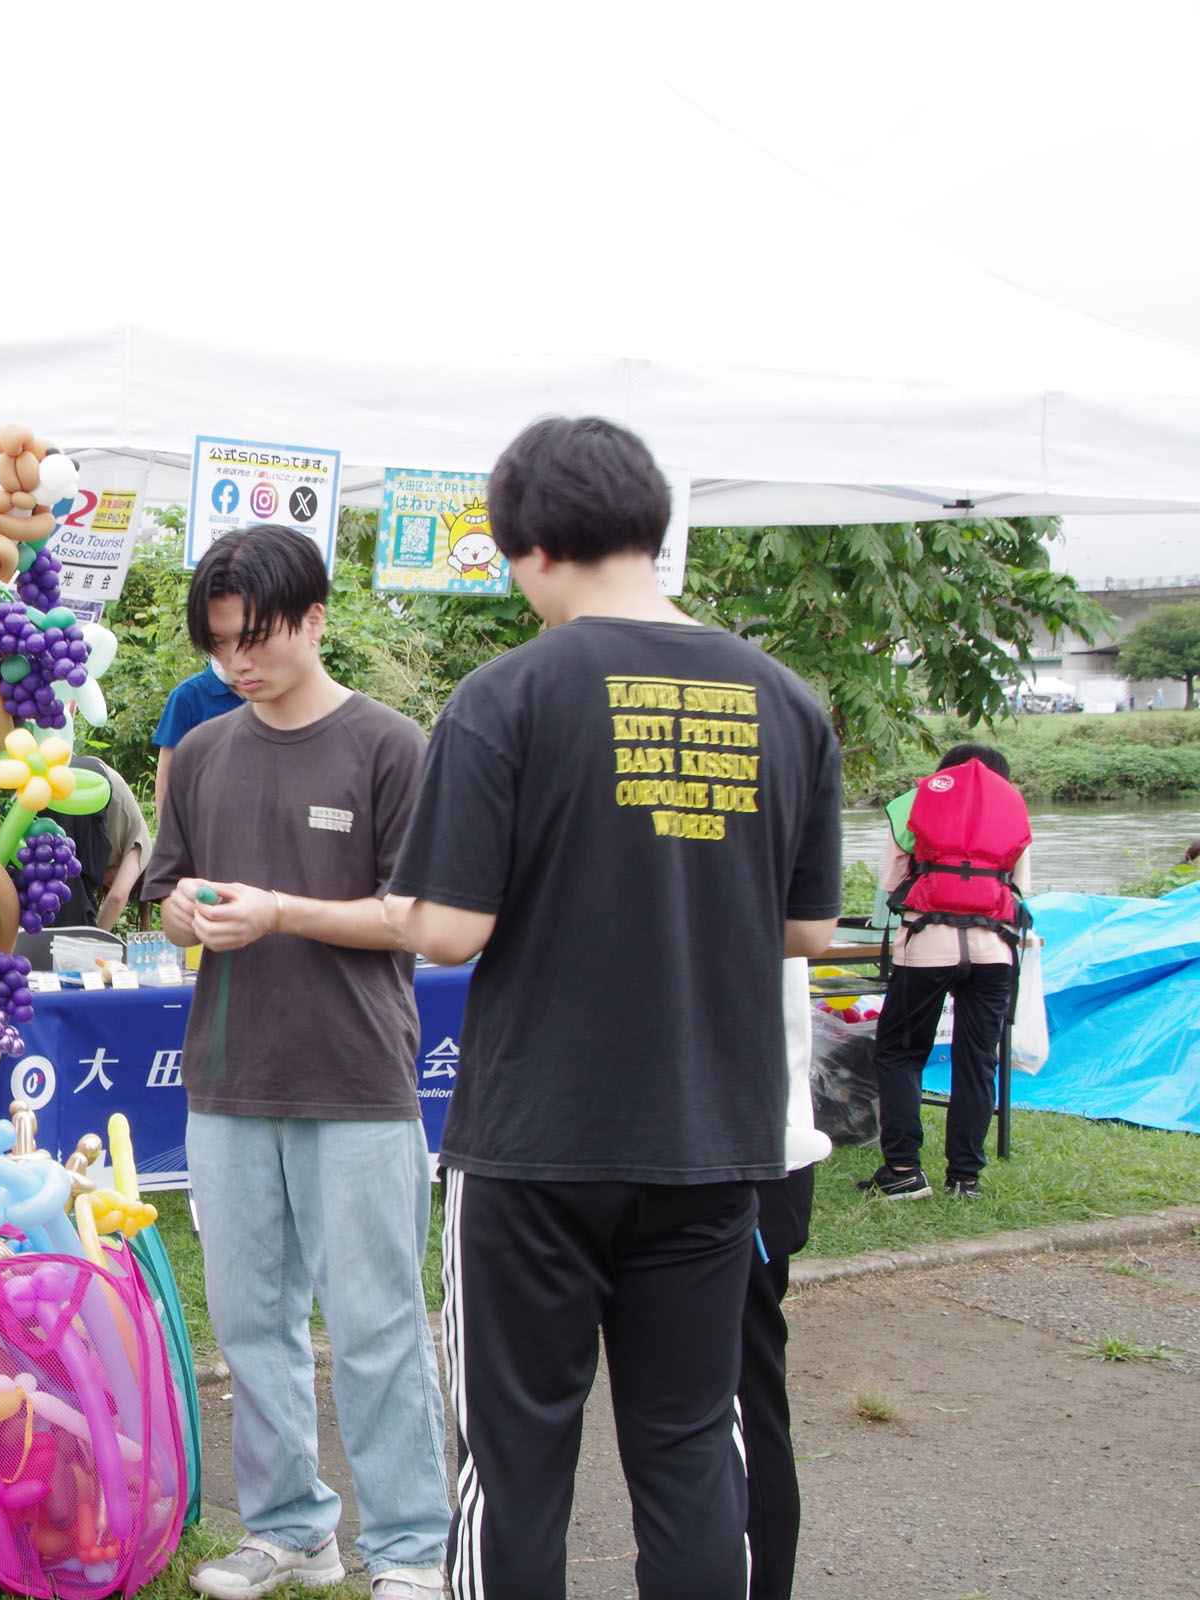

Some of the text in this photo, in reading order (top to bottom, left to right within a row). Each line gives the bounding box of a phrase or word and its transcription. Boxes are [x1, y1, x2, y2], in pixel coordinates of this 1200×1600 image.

[396, 480, 489, 496] 大田区公式PRキャラ
[51, 544, 120, 561] Association
[61, 531, 124, 548] Ota Tourist
[606, 683, 682, 710] FLOWER
[611, 715, 760, 748] KITTY PETTIN
[614, 747, 761, 781] BABY KISSIN
[712, 784, 759, 813] ROCK
